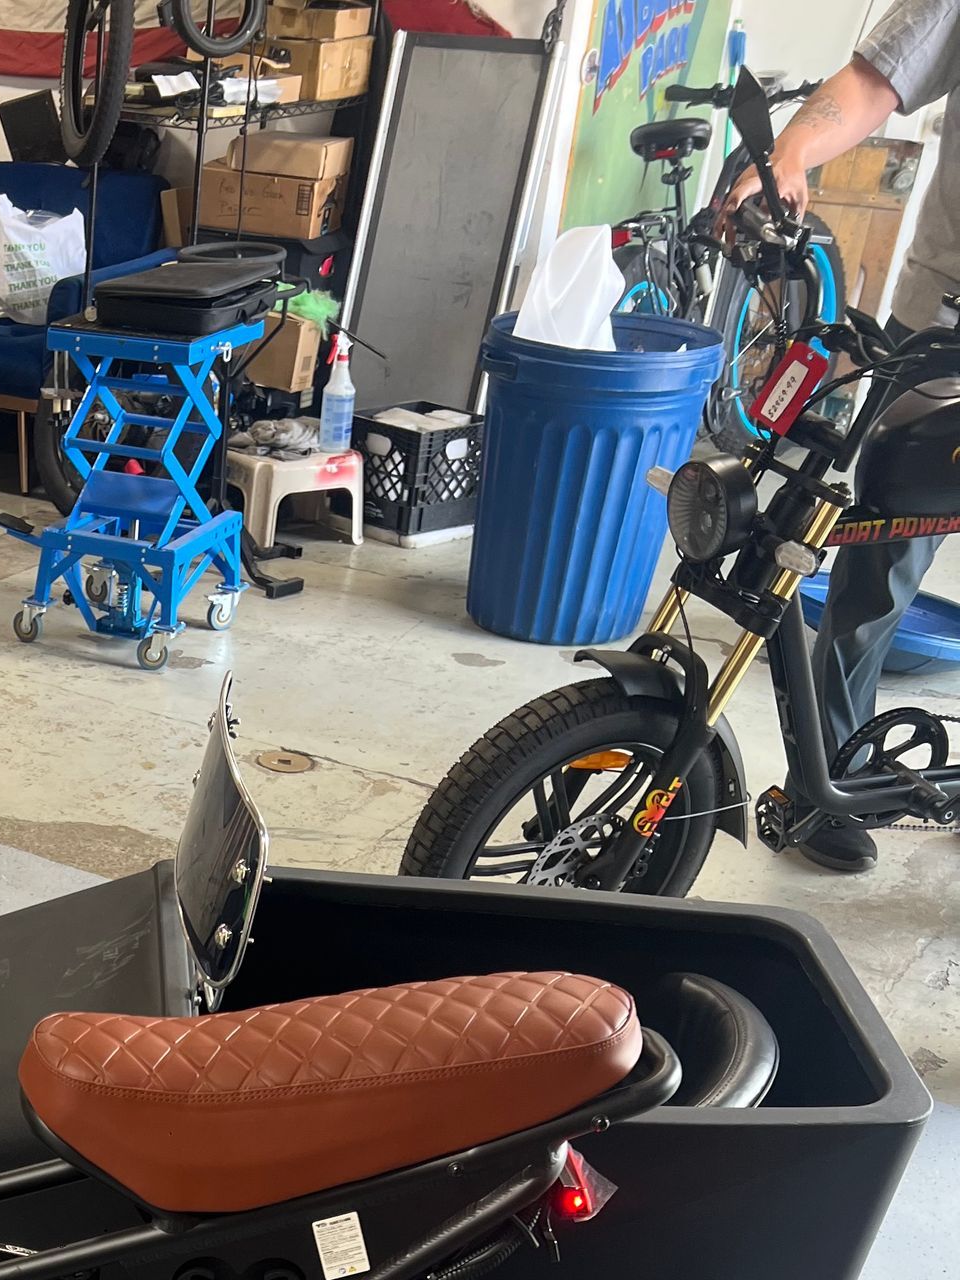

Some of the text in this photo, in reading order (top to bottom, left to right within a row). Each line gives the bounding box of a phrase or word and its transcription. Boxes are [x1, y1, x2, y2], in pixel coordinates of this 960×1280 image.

[639, 24, 691, 101] PARK
[28, 243, 46, 252] YOU
[4, 260, 34, 273] THANK
[8, 275, 59, 293] THANK YOU
[827, 519, 886, 545] GOAT
